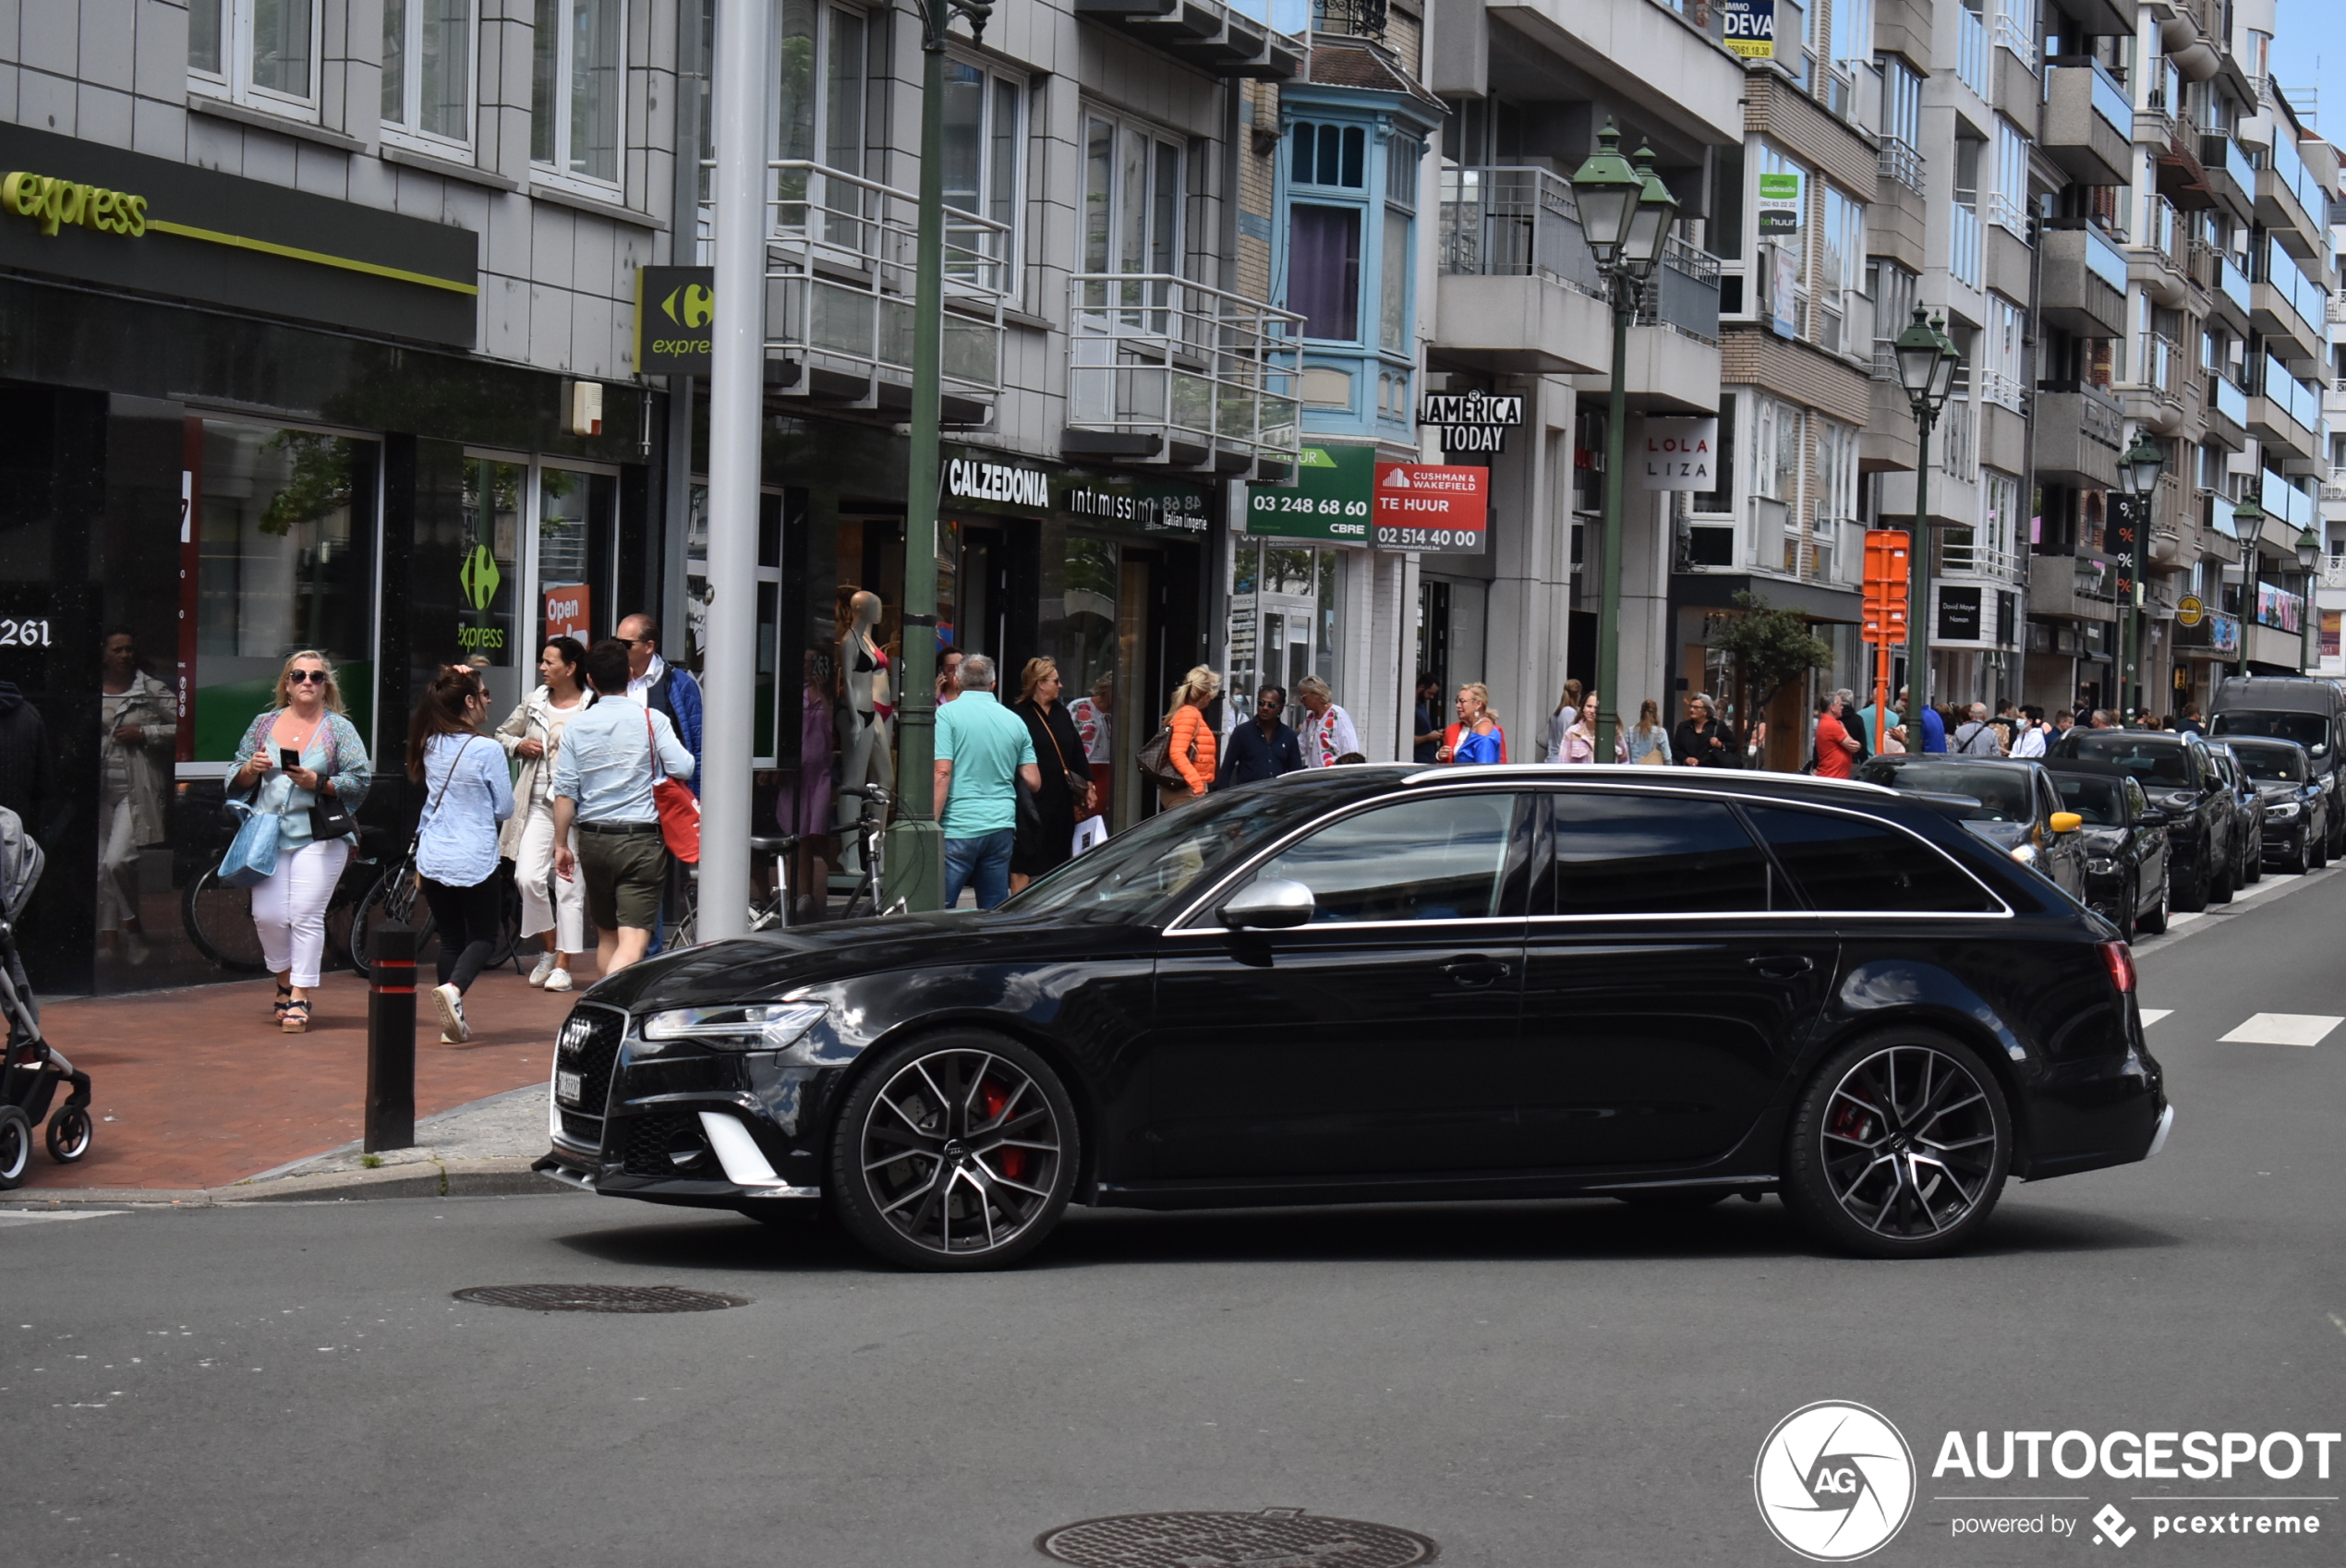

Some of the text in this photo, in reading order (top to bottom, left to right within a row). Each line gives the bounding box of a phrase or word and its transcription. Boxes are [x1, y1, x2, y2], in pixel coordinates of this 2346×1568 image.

[1725, 3, 1749, 11] IMMO
[1724, 13, 1773, 36] DEVA
[3, 172, 148, 236] express
[1428, 396, 1519, 424] AMERICA
[1444, 425, 1504, 451] TODAY
[1649, 438, 1709, 452] LOLA
[1413, 471, 1476, 483] CUSHMAN &
[1648, 462, 1708, 477] LIZA
[949, 457, 1049, 508] CALZEDONIA
[1413, 480, 1476, 491] WAKEFIELD
[1071, 486, 1154, 524] intimissimi
[1253, 495, 1368, 516] 03 248 68 60
[1380, 497, 1450, 513] TE HUUR
[1163, 509, 1183, 527] Italian
[1184, 513, 1207, 533] lingerie
[1330, 523, 1365, 535] CBRE
[1376, 542, 1441, 551] cushmanwakefield.be
[1377, 526, 1476, 547] 02 514 40 00
[548, 597, 579, 625] Open
[1942, 602, 1958, 610] David
[1949, 615, 1969, 623] Naman
[0, 619, 52, 647] 261
